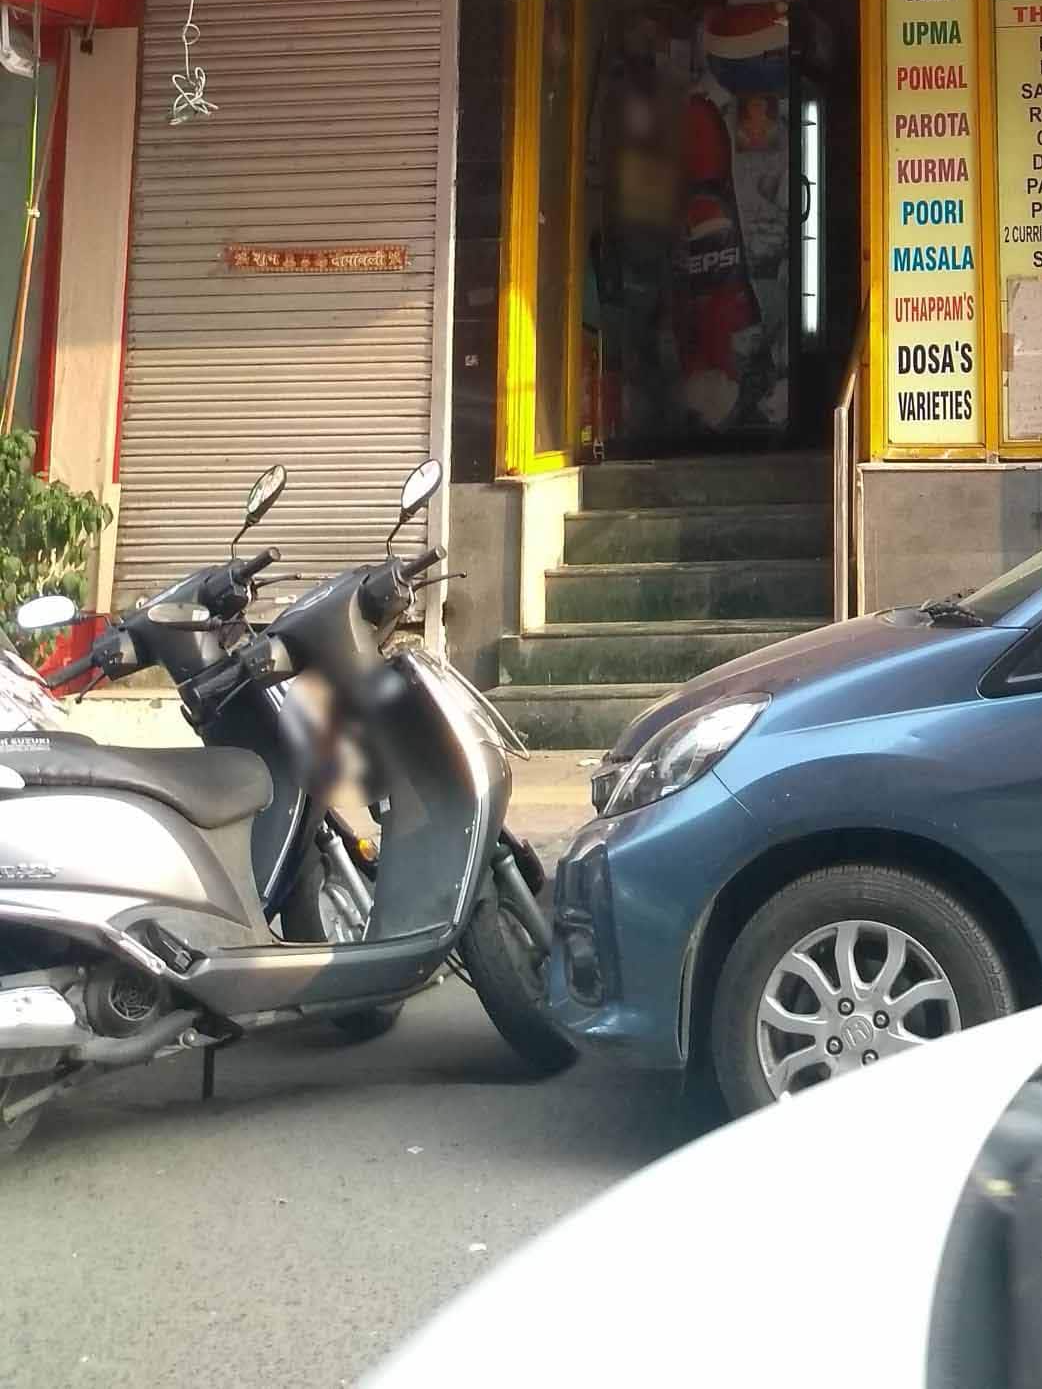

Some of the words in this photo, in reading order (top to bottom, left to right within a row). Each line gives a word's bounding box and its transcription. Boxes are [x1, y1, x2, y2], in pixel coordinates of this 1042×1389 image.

[903, 20, 961, 46] UPMA
[897, 65, 967, 90] PONGAL
[895, 112, 970, 138] PAROTA
[897, 158, 969, 184] KURMA
[902, 199, 964, 226] POORI
[1004, 227, 1010, 242] 2
[893, 245, 974, 272] MASALA
[895, 293, 974, 322] UTHAPPAM'S
[897, 340, 972, 374] DOSA'S
[898, 390, 972, 421] VARIETIES
